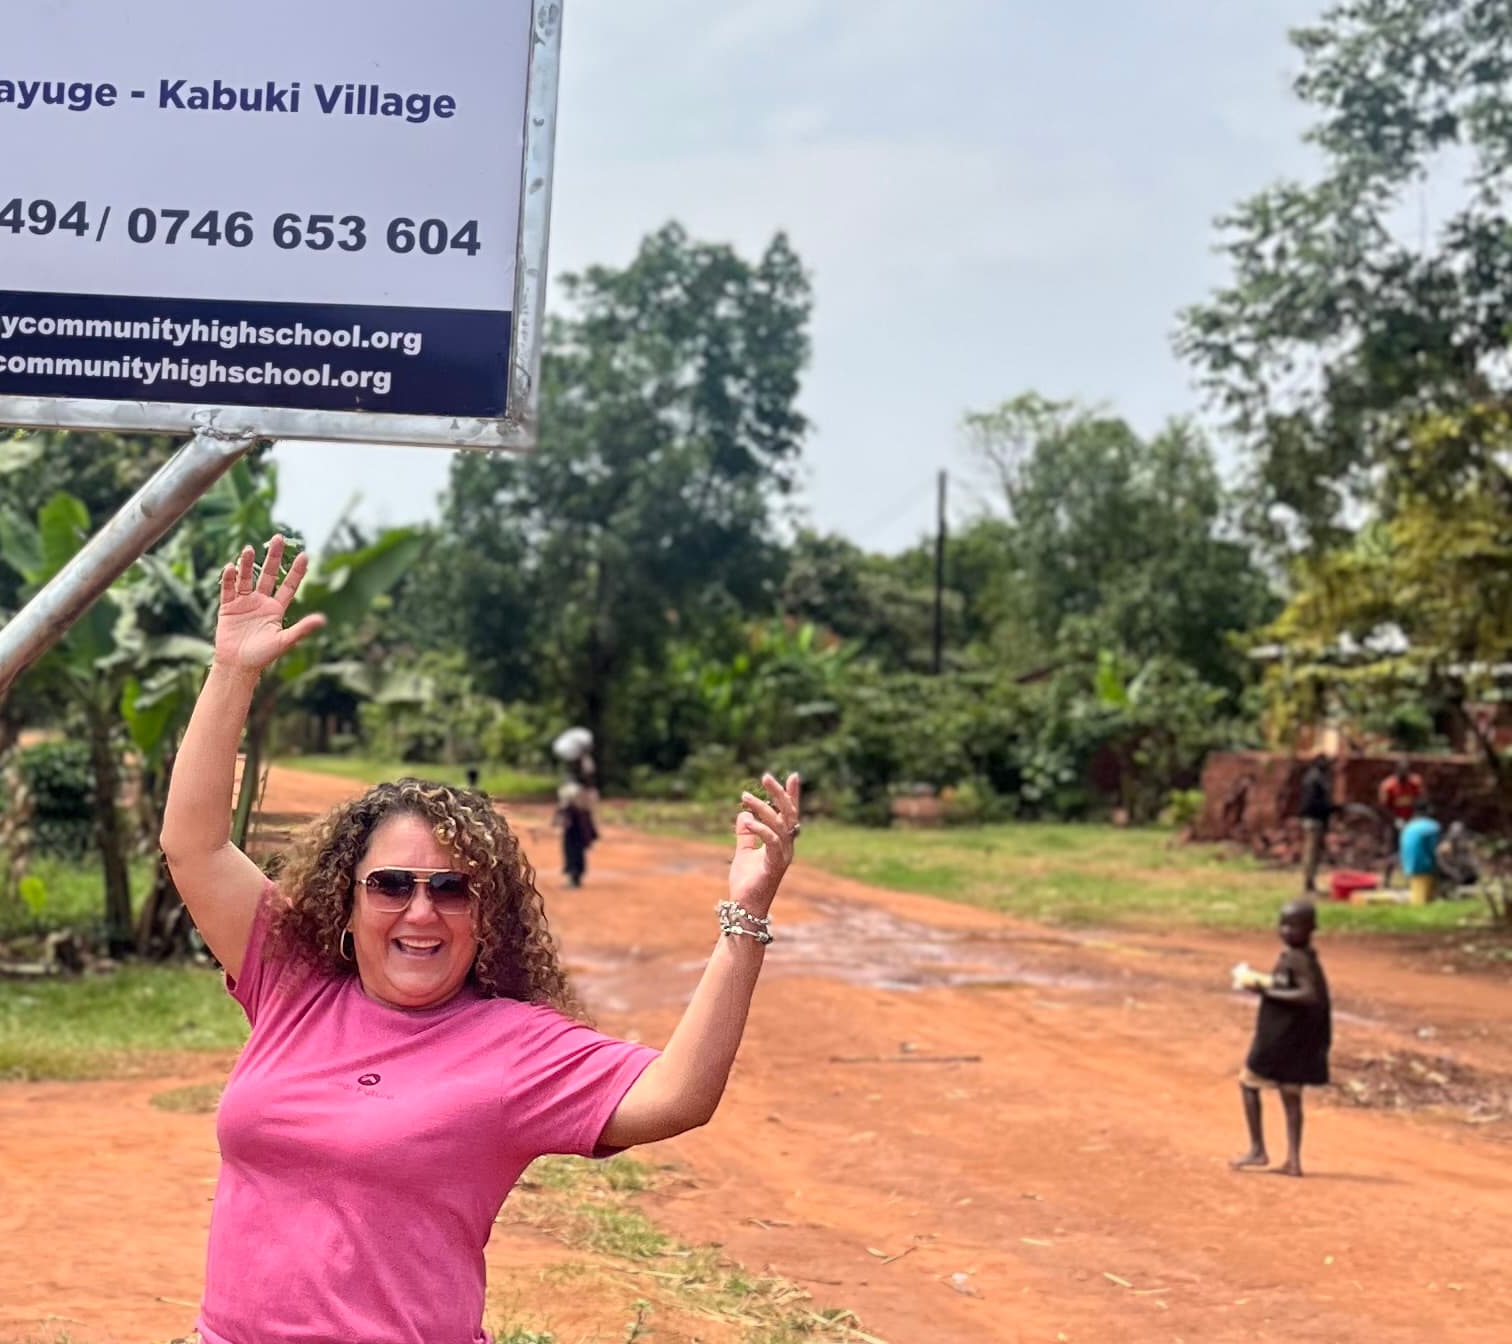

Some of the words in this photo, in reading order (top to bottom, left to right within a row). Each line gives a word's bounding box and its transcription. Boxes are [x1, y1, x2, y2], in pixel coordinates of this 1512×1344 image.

[160, 80, 300, 112] Kabuki
[315, 84, 456, 123] Village
[128, 208, 253, 247] 0746
[273, 213, 366, 251] 653
[387, 218, 480, 256] 604
